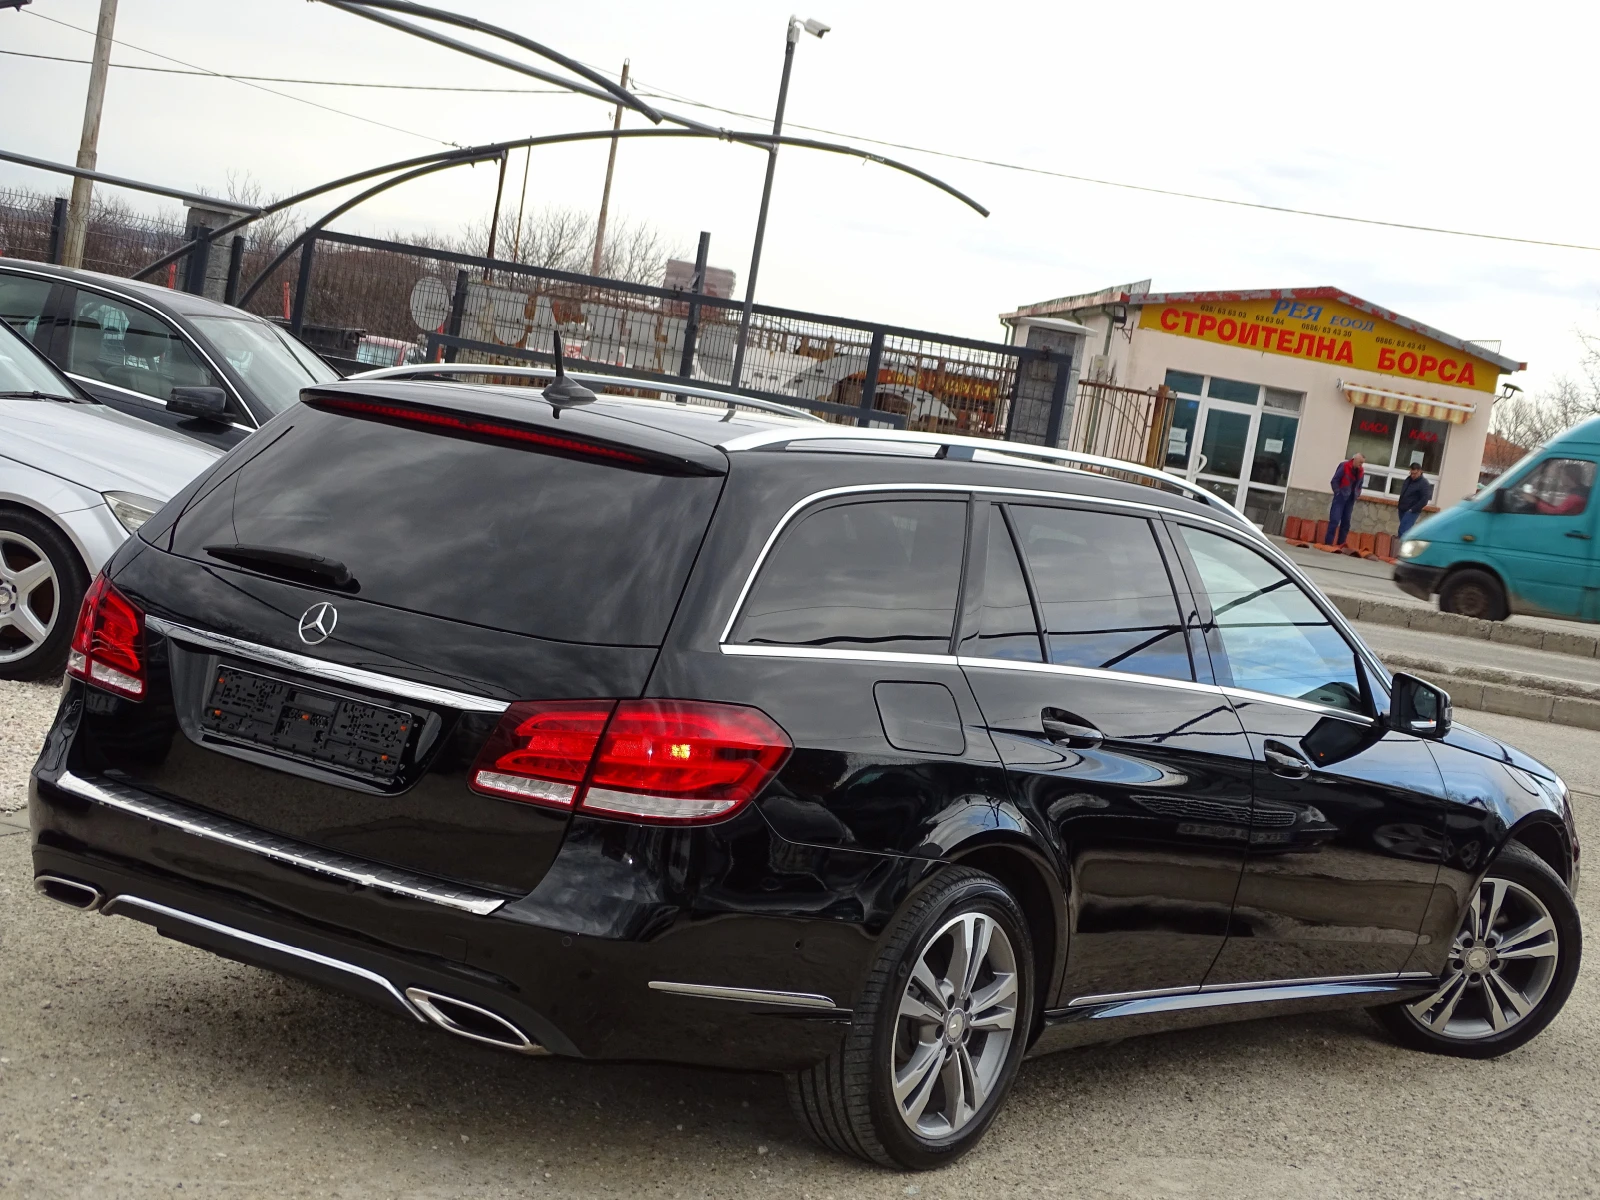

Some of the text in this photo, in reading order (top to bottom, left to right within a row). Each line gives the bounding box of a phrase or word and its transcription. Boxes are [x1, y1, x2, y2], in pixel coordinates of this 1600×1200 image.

[1272, 299, 1375, 333] РЕЯ ЕООД
[1160, 307, 1476, 386] СТРОИТЕЛНА БОРСА
[1359, 420, 1389, 434] КАСА
[1409, 429, 1438, 443] КАСА
